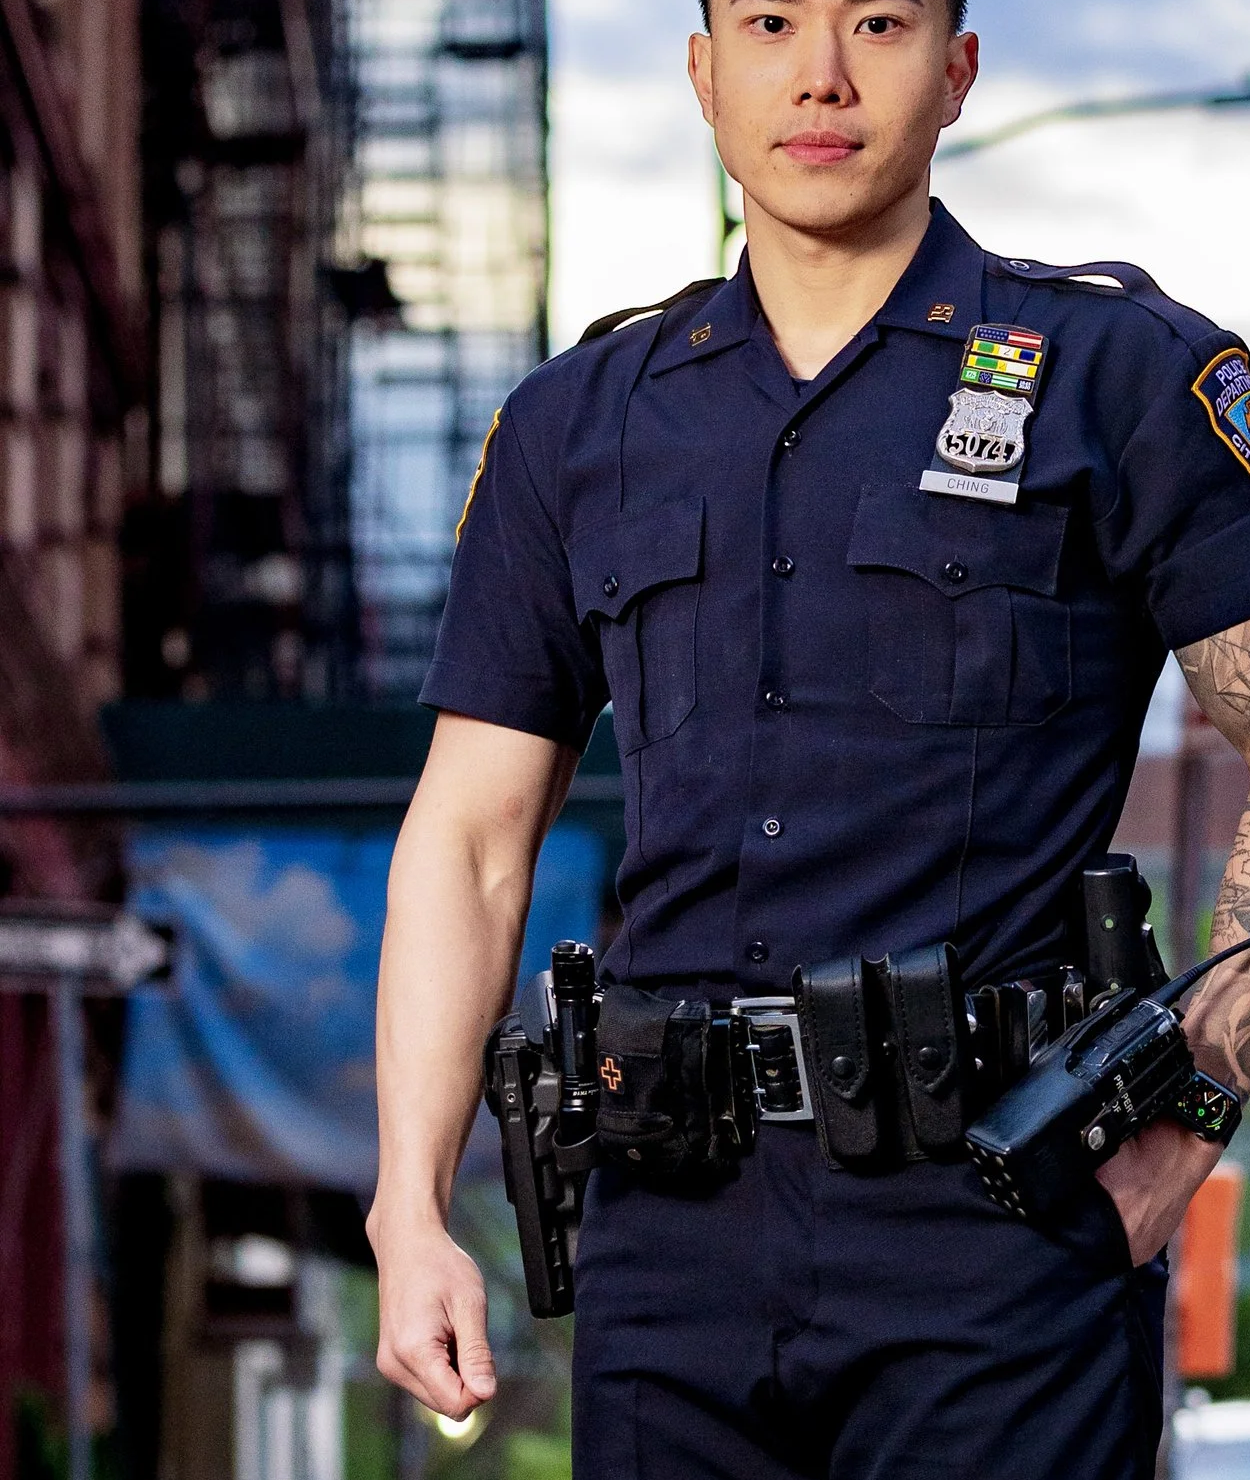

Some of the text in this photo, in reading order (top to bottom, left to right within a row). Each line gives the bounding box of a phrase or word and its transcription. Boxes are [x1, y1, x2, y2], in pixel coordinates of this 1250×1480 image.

[1003, 348, 1011, 356] 2
[1215, 359, 1248, 387] POLICE
[949, 432, 1008, 463] 5074
[947, 478, 990, 494] CHING
